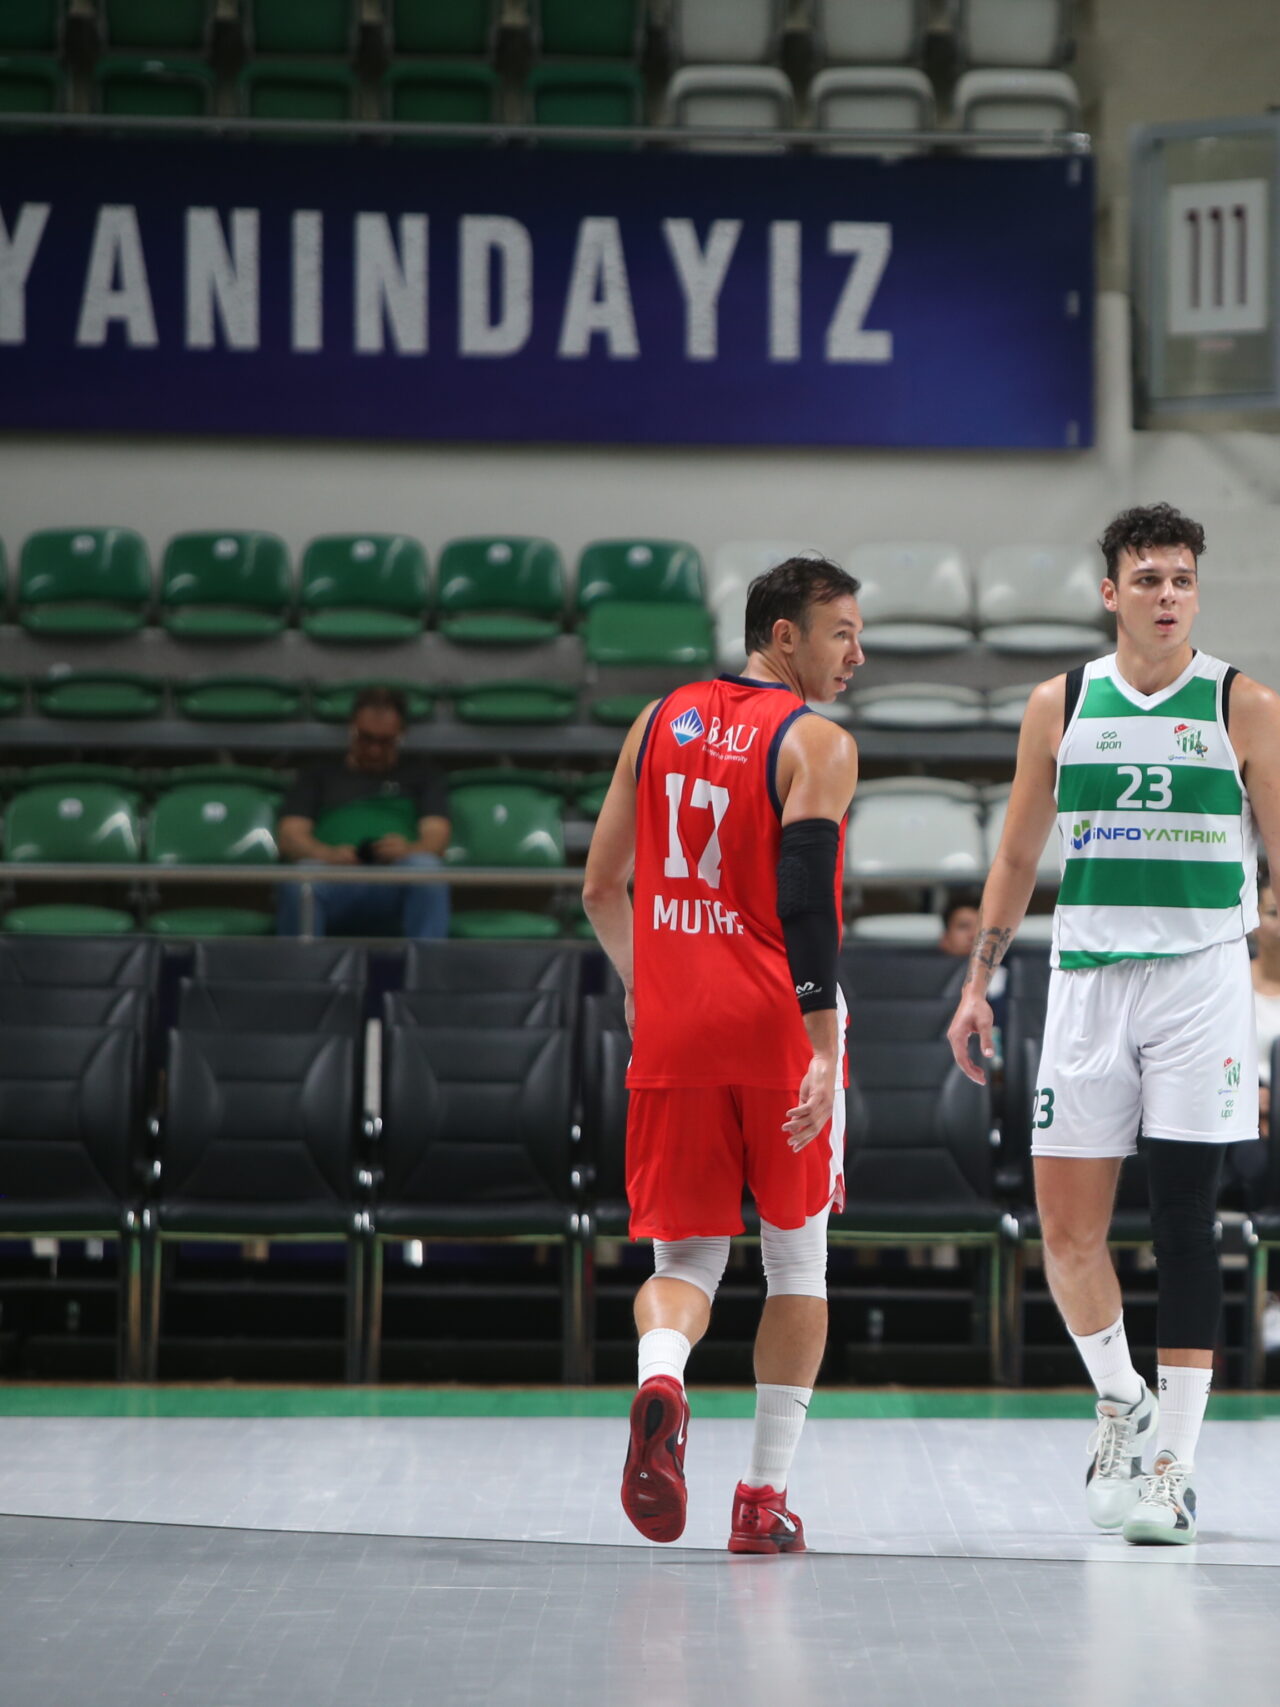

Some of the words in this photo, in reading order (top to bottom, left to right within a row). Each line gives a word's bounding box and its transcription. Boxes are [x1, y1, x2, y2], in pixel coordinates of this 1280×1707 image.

[0, 203, 894, 362] YANINDAYIZ
[704, 716, 759, 752] BAU
[1096, 740, 1122, 752] upon
[1116, 765, 1173, 810] 23
[664, 772, 730, 889] 17
